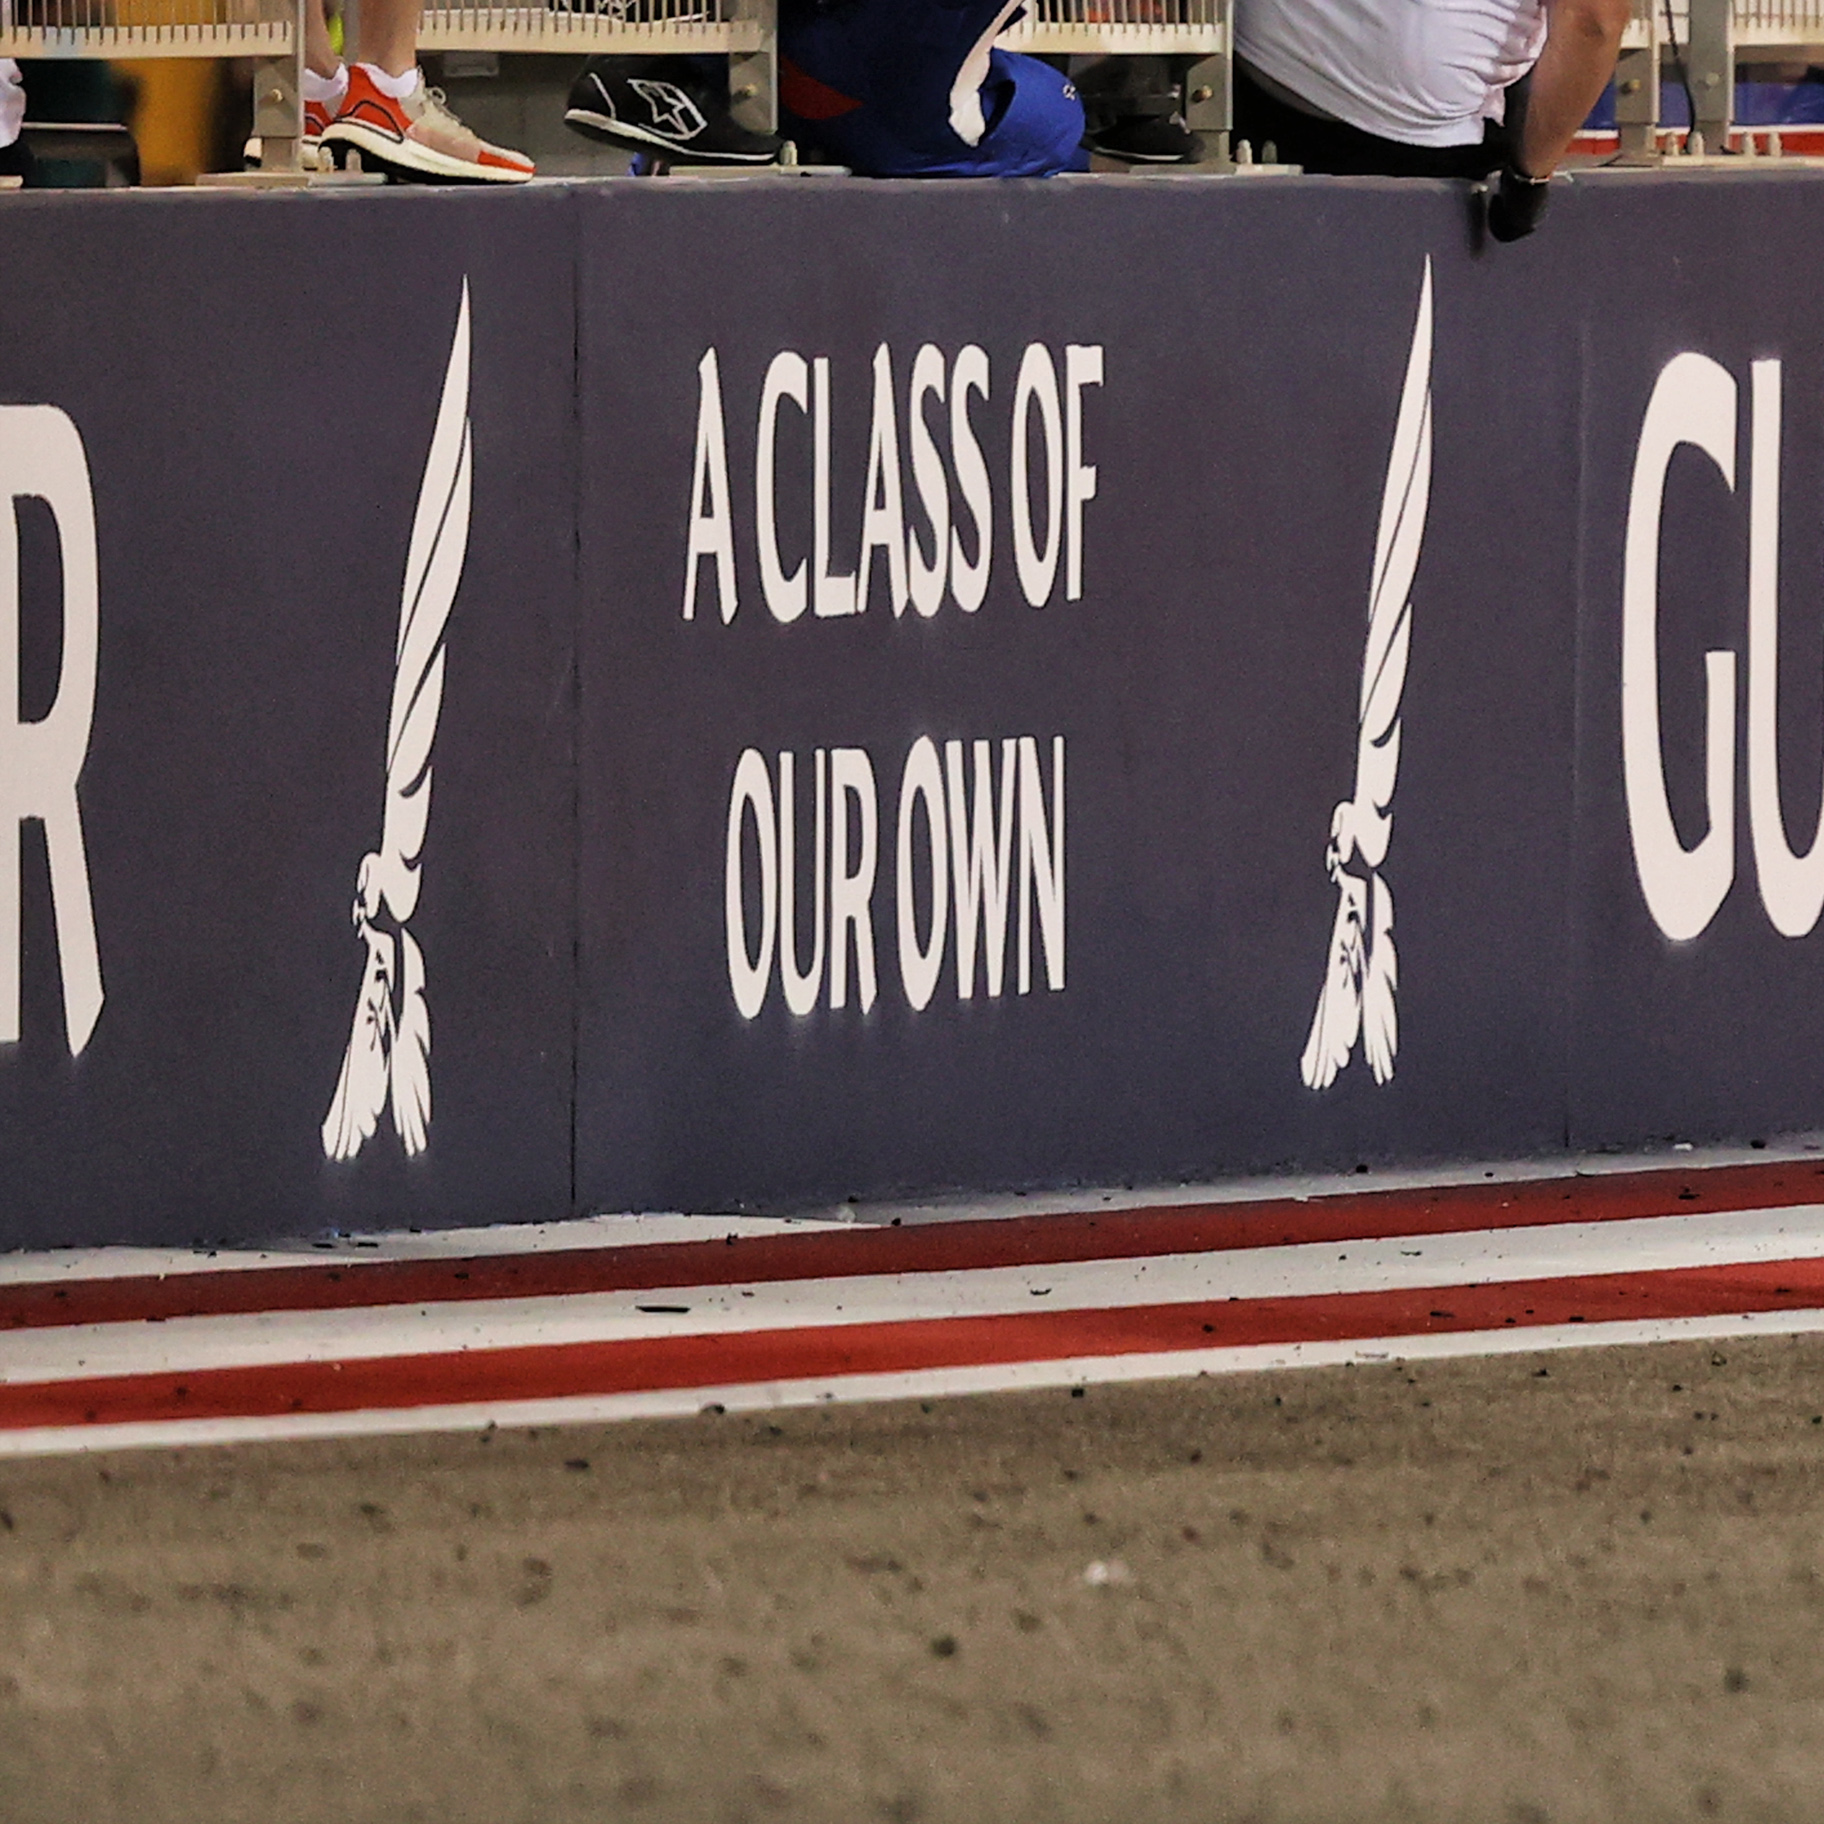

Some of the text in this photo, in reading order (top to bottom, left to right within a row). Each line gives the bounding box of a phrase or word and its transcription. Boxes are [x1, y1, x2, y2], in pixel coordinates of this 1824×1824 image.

[682, 341, 1104, 625] A CLASS OF
[725, 734, 1066, 1020] OUR OWN
